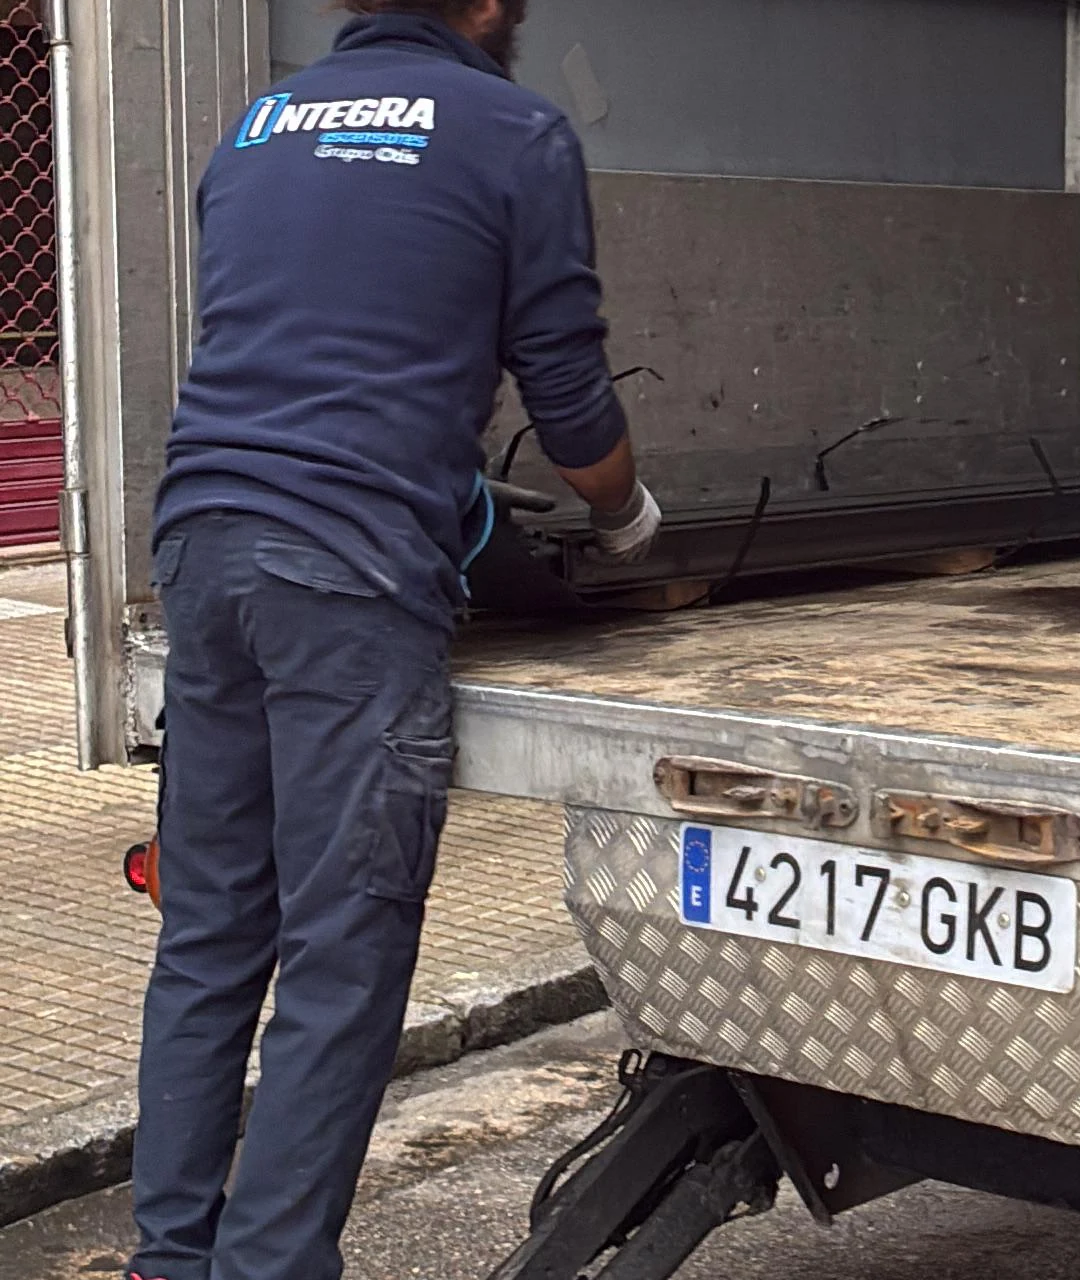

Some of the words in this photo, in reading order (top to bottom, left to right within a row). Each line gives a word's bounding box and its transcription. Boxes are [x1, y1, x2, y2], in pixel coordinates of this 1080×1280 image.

[691, 886, 702, 907] E
[725, 846, 891, 942] 4217
[920, 876, 1053, 973] GKB
